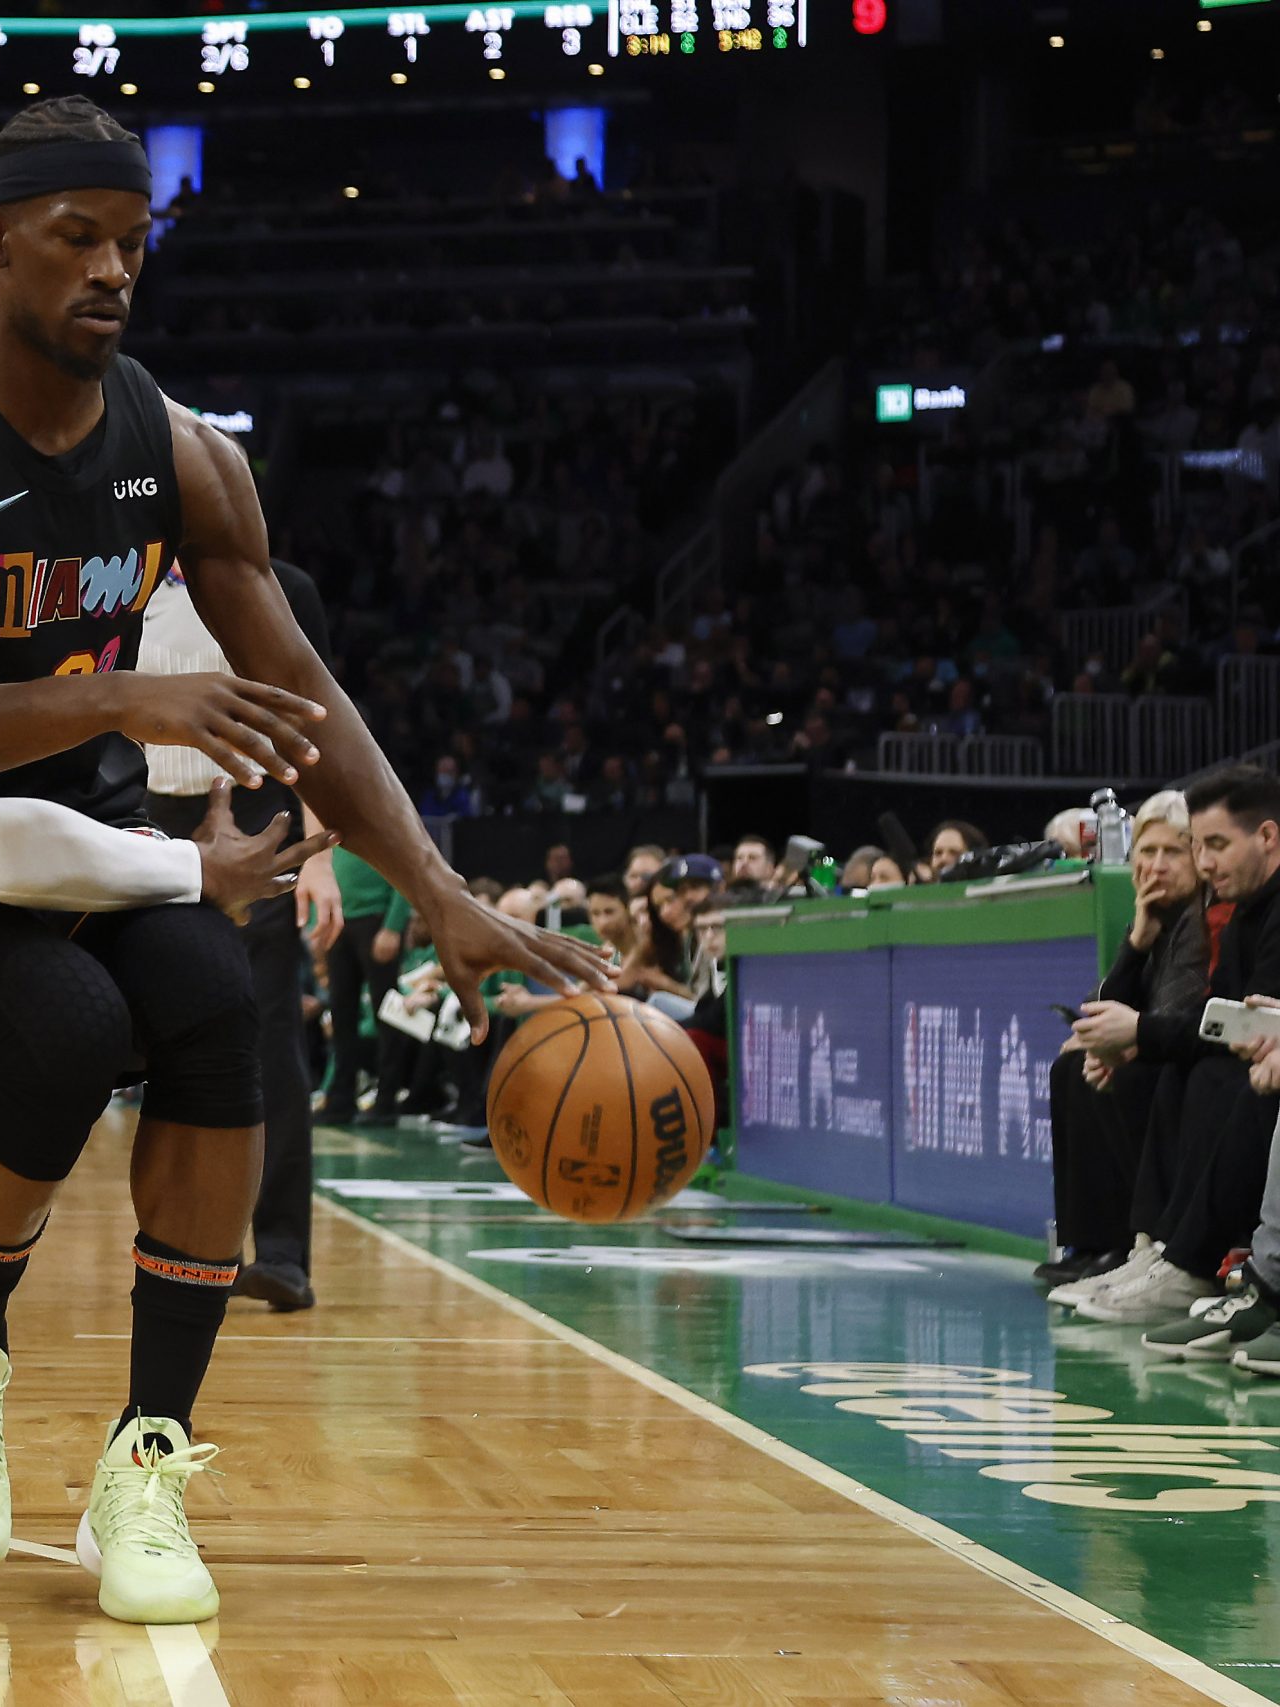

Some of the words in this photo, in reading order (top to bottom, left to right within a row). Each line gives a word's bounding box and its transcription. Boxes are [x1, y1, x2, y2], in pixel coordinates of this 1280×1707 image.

[308, 16, 344, 39] TO
[388, 13, 430, 36] STL
[466, 8, 515, 32] AST
[321, 40, 334, 66] 1
[404, 36, 417, 63] 1
[484, 32, 502, 59] 2
[73, 47, 120, 77] 2/7
[913, 385, 965, 410] Bank
